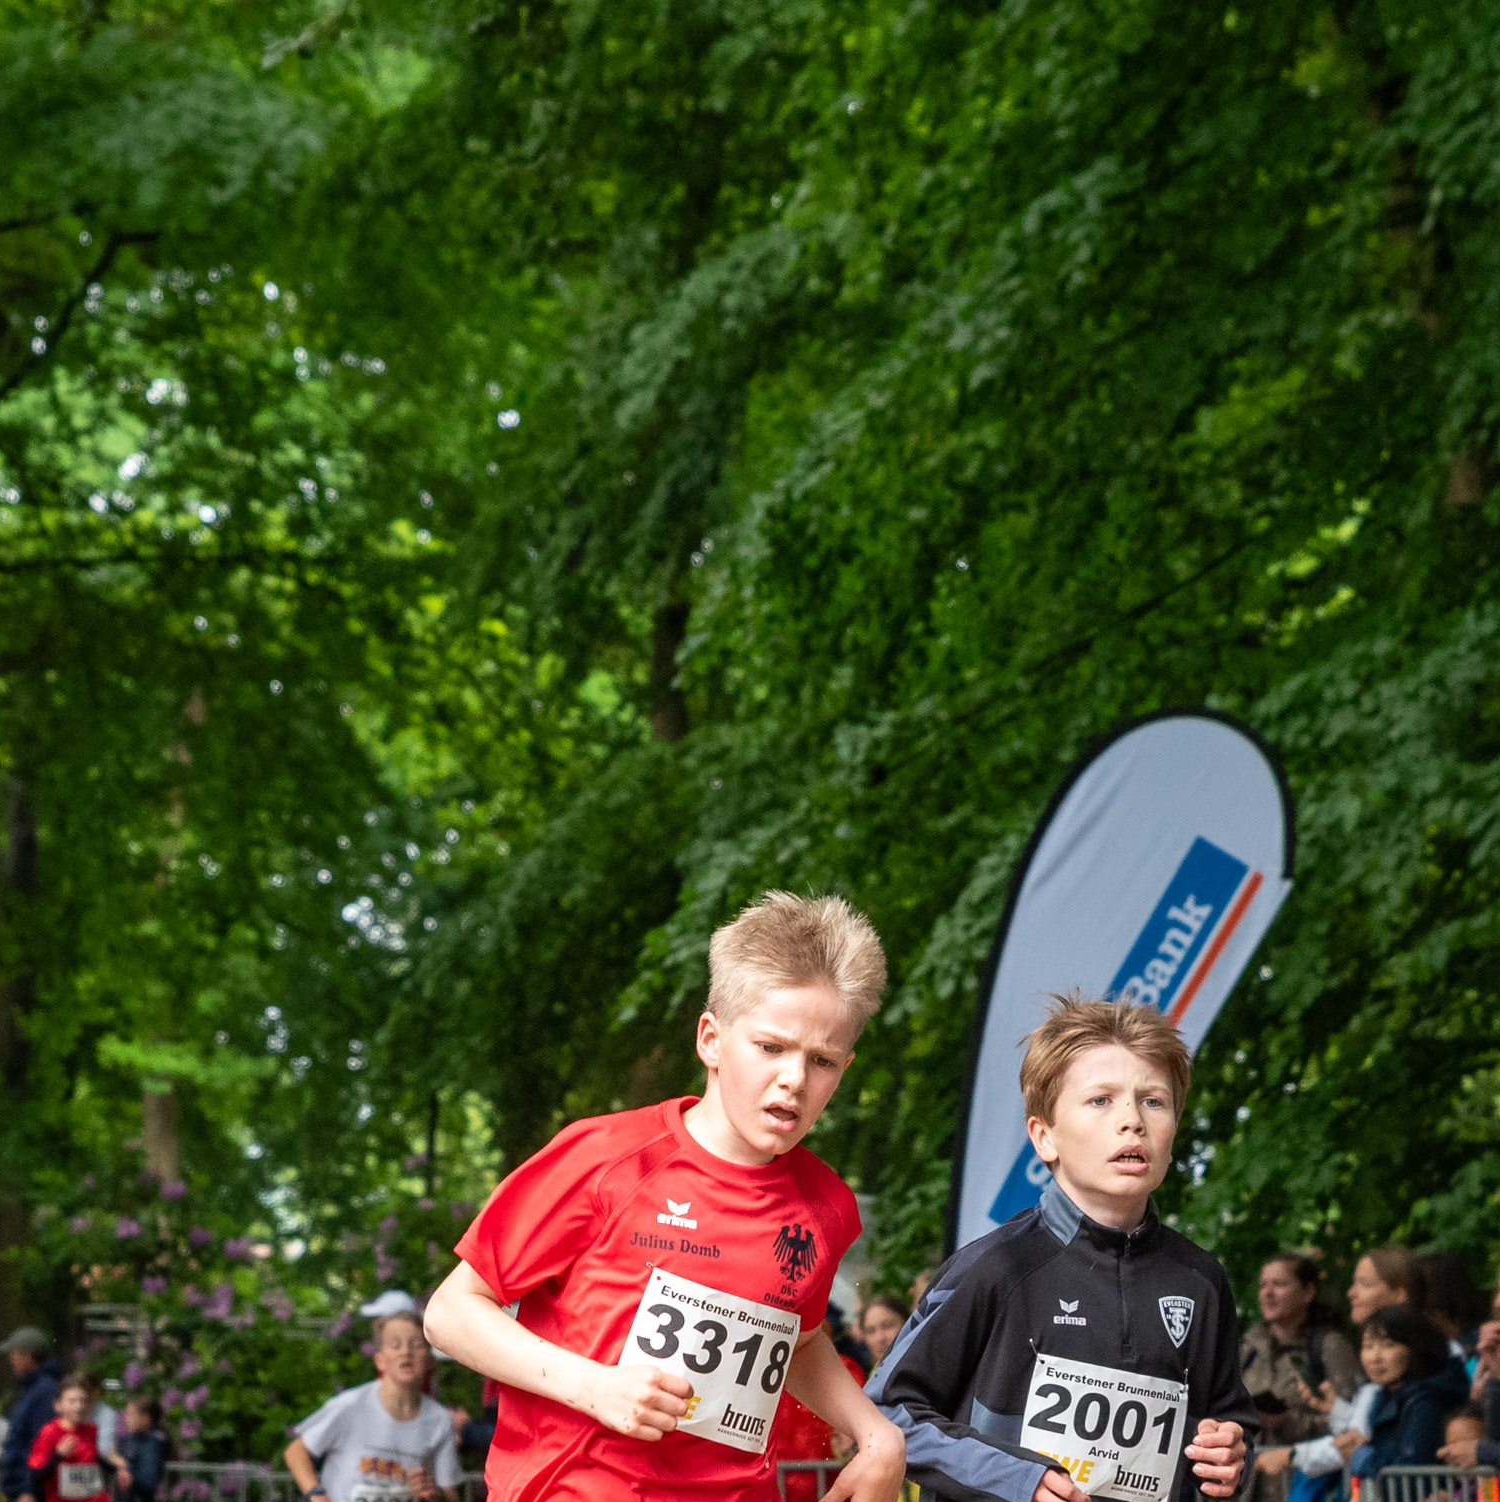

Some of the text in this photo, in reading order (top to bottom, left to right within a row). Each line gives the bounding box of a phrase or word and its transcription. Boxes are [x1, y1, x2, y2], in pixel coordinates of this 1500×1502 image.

[656, 1213, 698, 1230] erima
[630, 1232, 721, 1259] Julius Domb
[660, 1284, 794, 1336] Everstener Brunnenlauf
[1053, 1314, 1087, 1326] erima
[636, 1303, 790, 1394] 3318
[1046, 1366, 1180, 1404] Everstener Brunnenlauf
[720, 1403, 766, 1436] bruns
[1027, 1383, 1177, 1456] 2001
[1037, 1450, 1095, 1483] WE
[1088, 1446, 1120, 1461] Arvid
[1113, 1464, 1160, 1493] bruns
